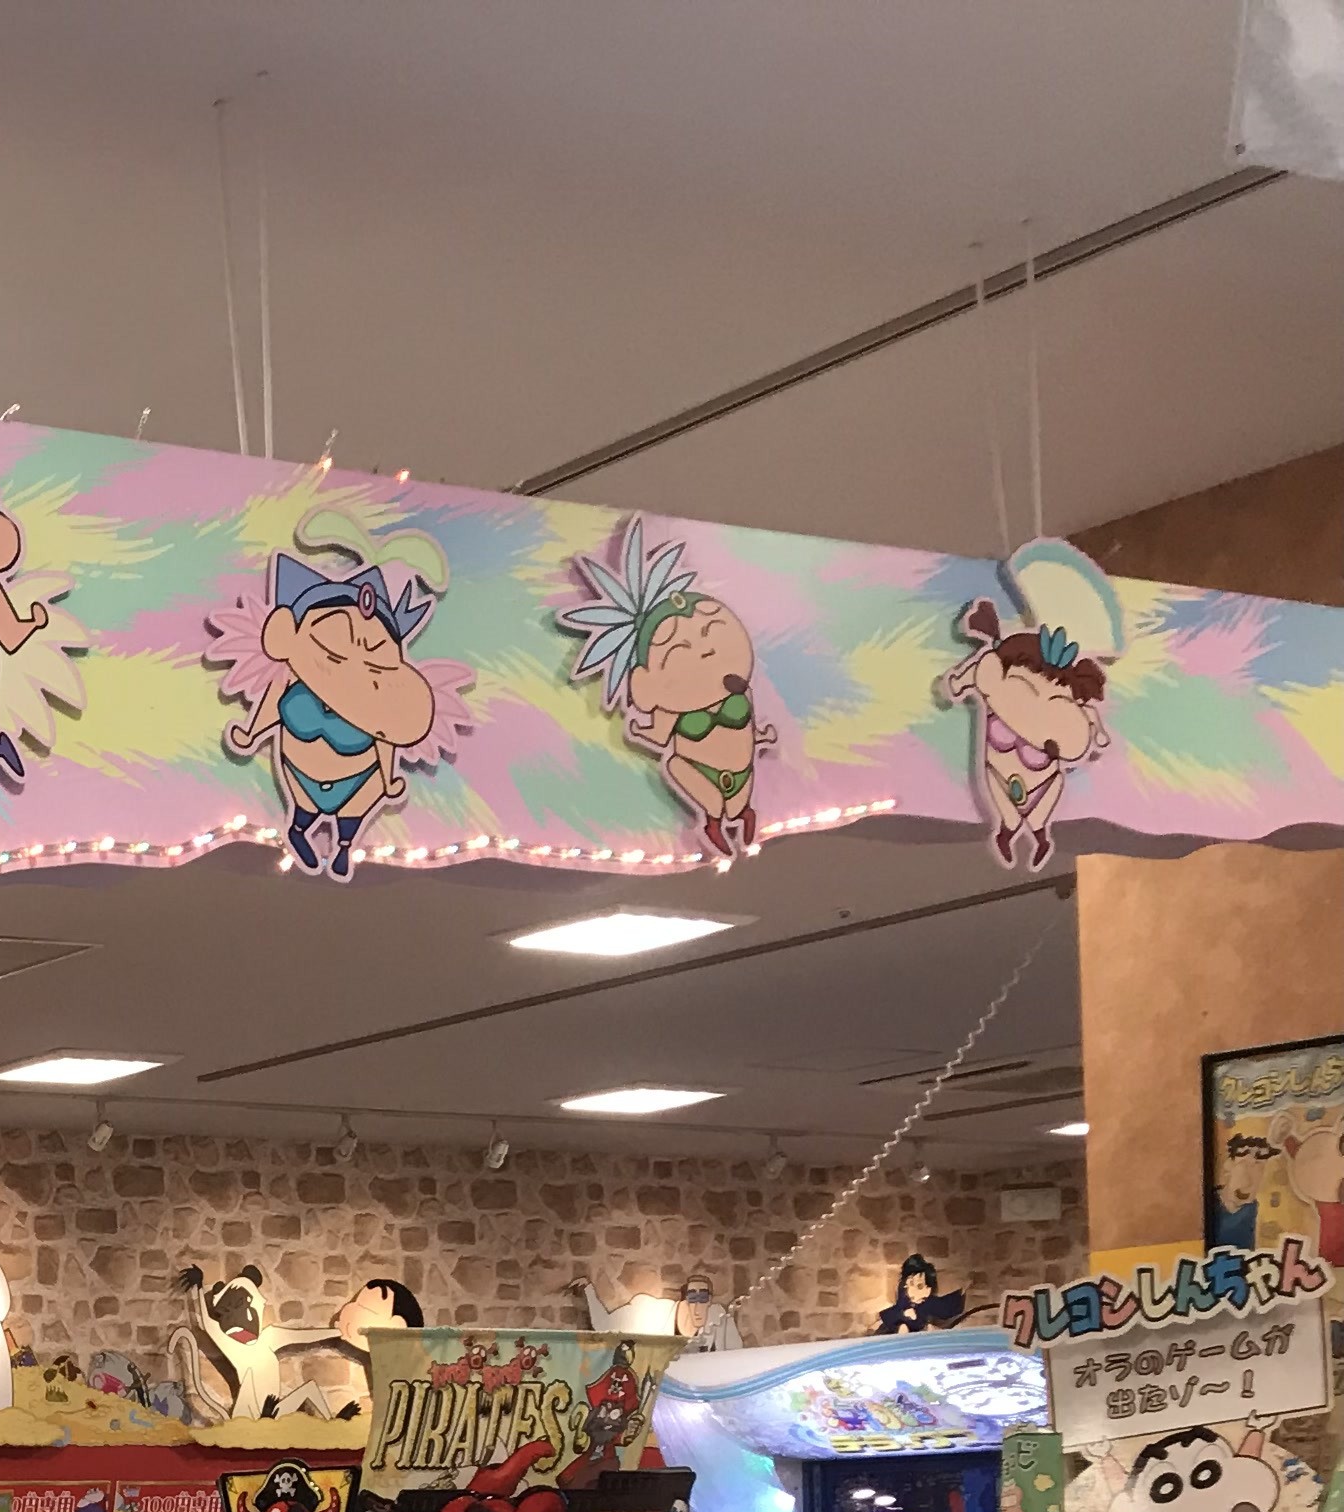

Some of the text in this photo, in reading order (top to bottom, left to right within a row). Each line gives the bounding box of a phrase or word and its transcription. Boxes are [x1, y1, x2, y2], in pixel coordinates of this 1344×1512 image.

[1004, 1239, 1325, 1349] クレヨンしんちゃん
[1074, 1323, 1295, 1389] オラのゲームが
